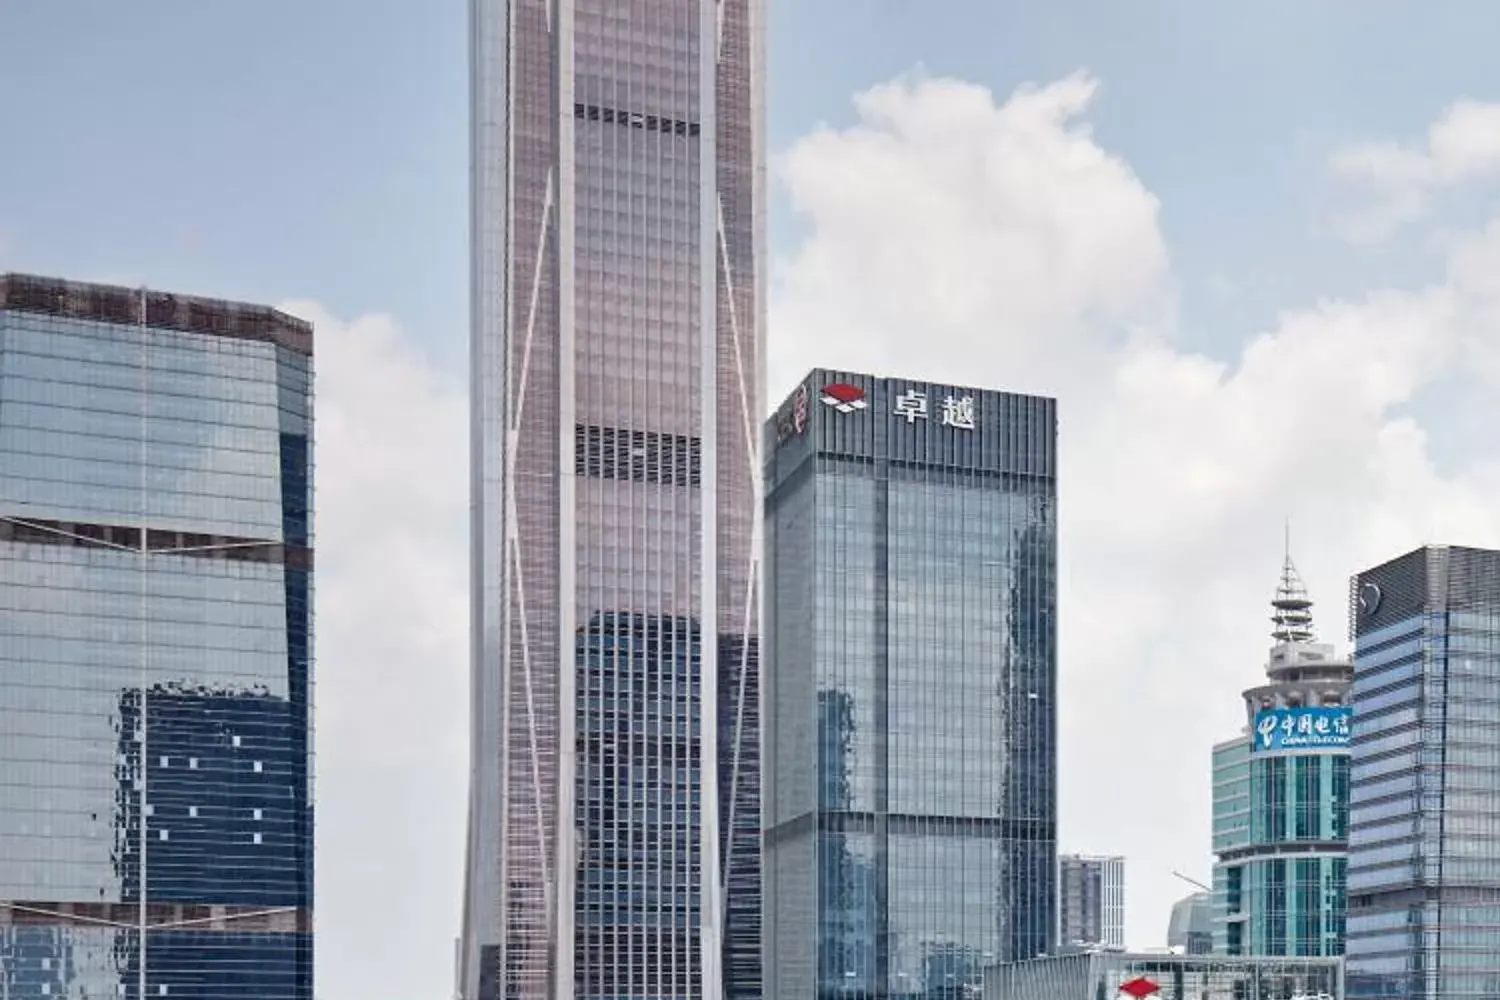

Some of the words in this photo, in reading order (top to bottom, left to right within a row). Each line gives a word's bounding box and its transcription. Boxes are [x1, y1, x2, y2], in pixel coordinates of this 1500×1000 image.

[893, 389, 975, 429] 卓越
[1281, 714, 1349, 737] 中国电信
